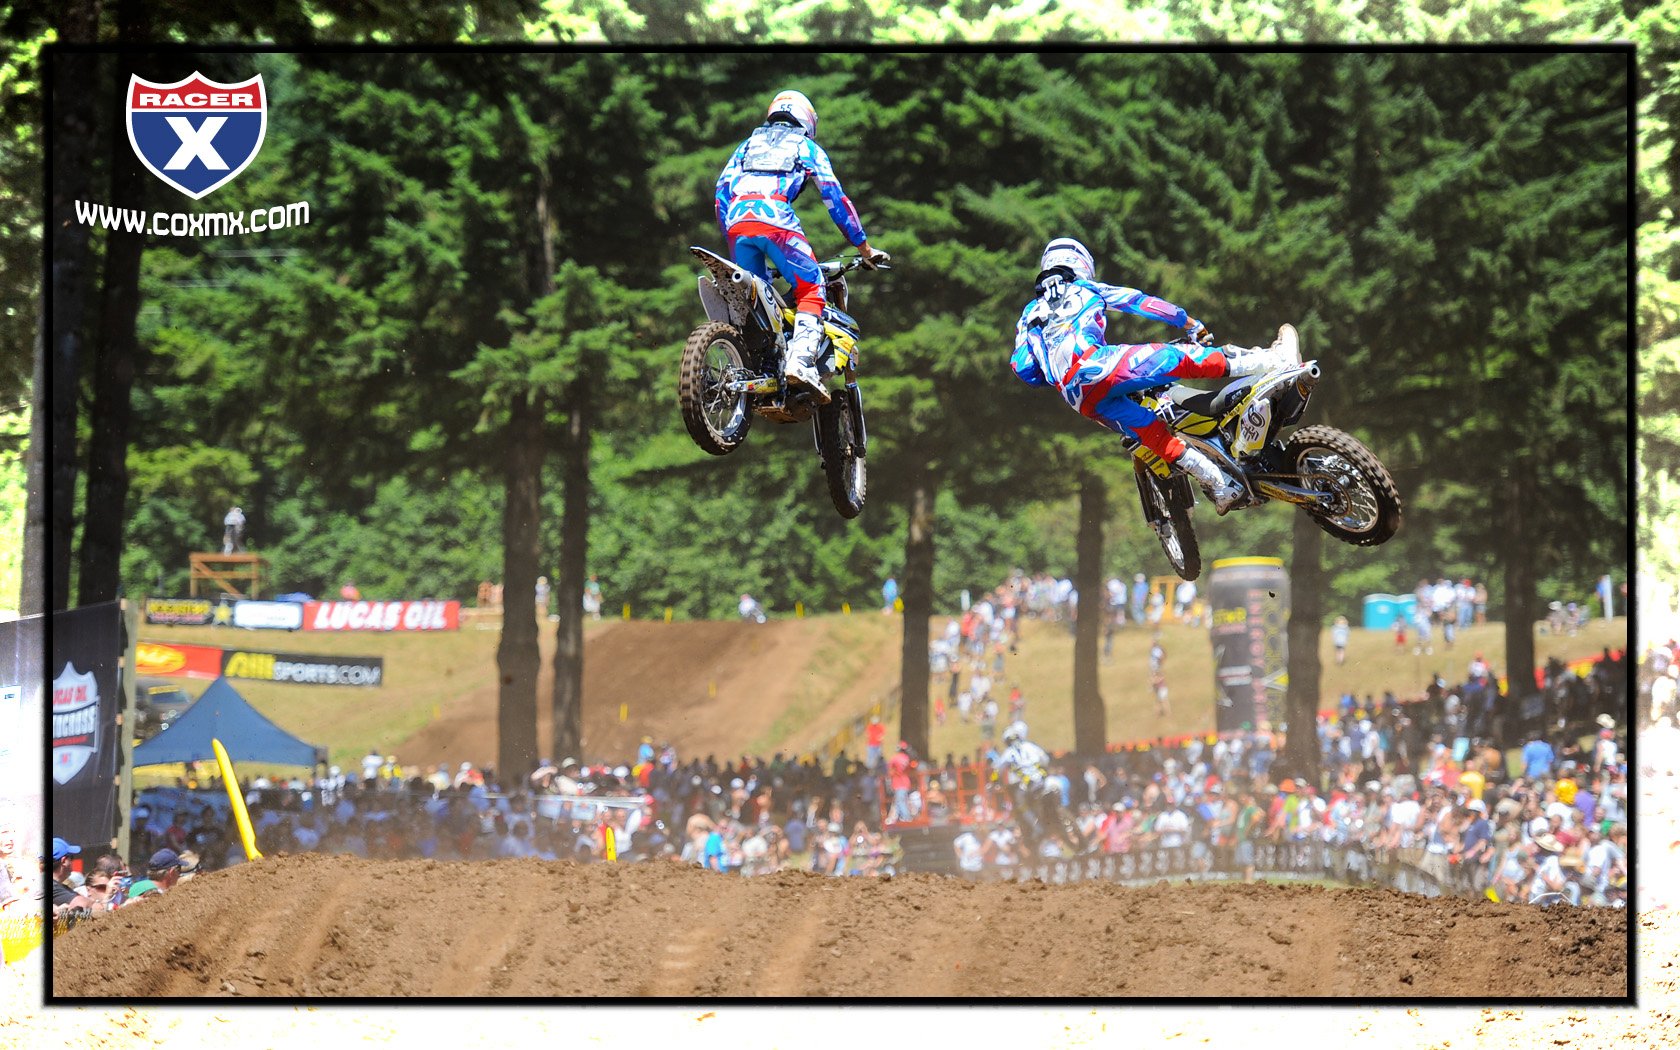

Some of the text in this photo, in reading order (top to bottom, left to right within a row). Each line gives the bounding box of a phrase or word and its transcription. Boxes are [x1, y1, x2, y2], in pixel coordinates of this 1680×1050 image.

[780, 103, 793, 113] 55
[313, 601, 404, 631] LUCAS
[404, 600, 447, 630] OIL
